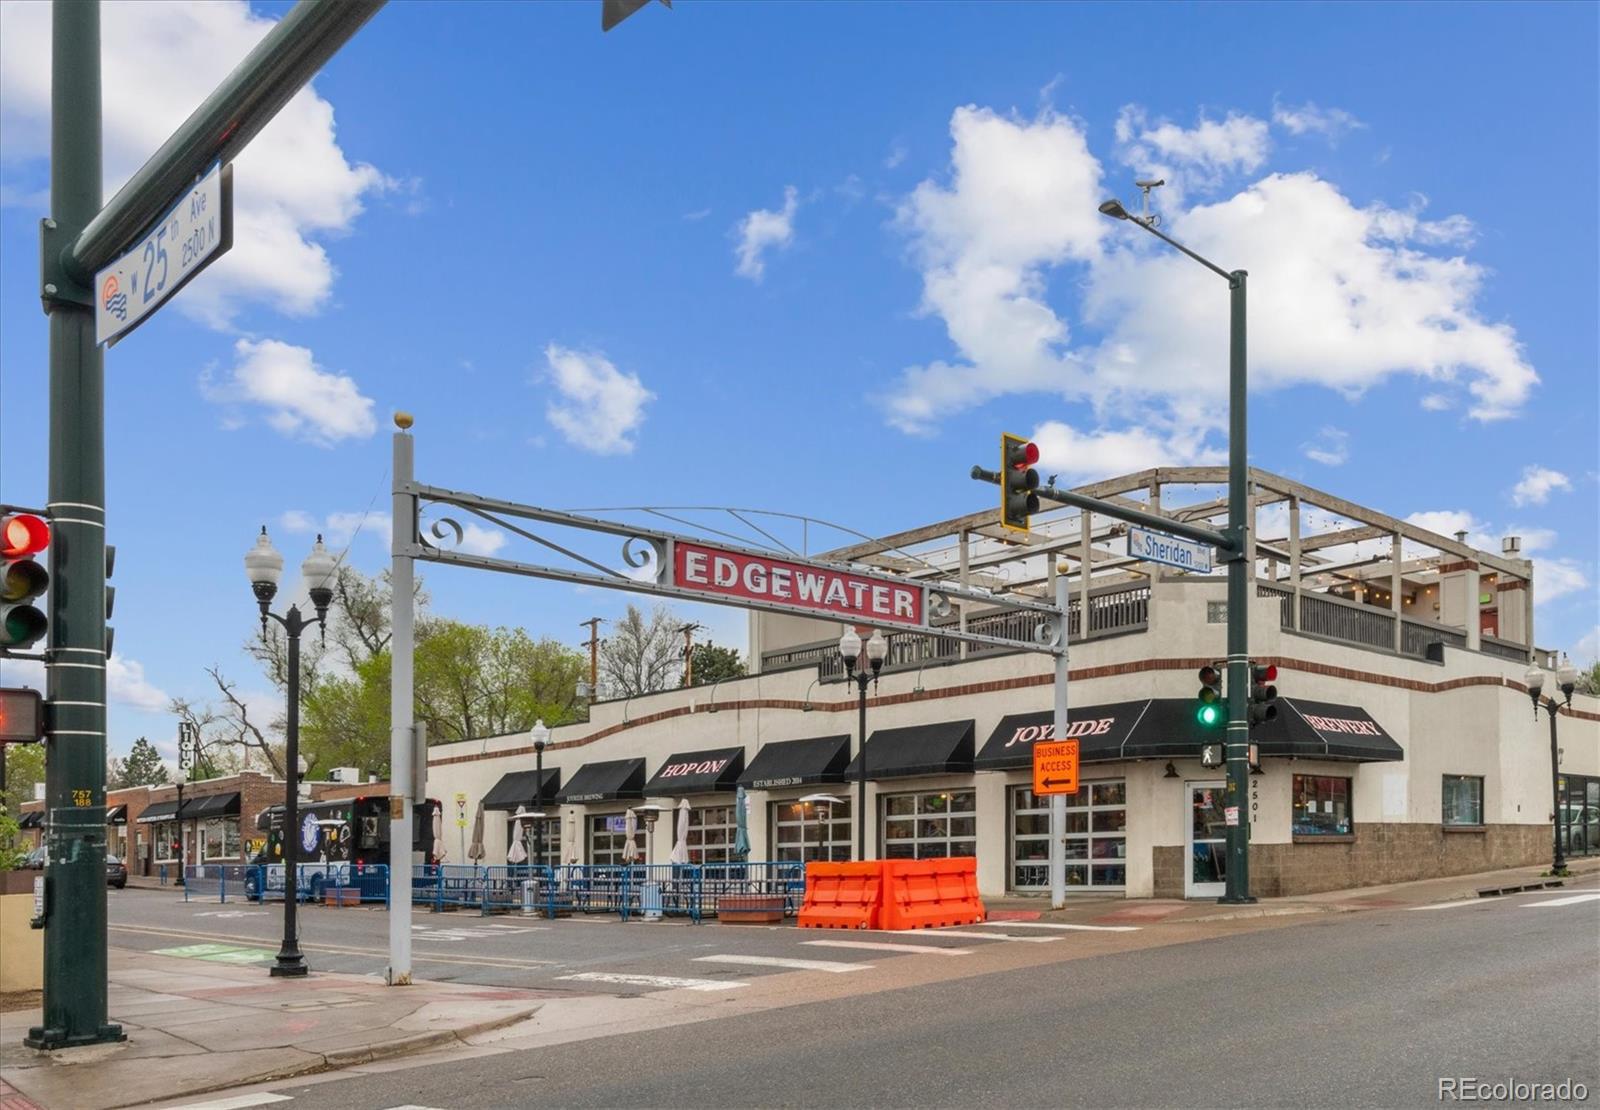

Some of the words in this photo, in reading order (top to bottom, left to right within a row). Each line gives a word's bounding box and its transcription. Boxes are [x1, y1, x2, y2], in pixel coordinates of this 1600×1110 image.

[131, 271, 138, 294] W
[190, 193, 206, 222] Ave
[182, 227, 204, 268] 2500
[208, 216, 214, 241] N
[1145, 535, 1192, 565] Sheridan
[685, 550, 914, 618] EDGEWATER
[1005, 718, 1115, 747] JOYIDE
[1302, 713, 1382, 736] BREWERY
[1036, 745, 1076, 758] BUSINESS
[659, 762, 698, 778] HOP
[695, 759, 728, 774] ON!
[1040, 760, 1072, 773] ACCESS
[72, 790, 91, 798] 757
